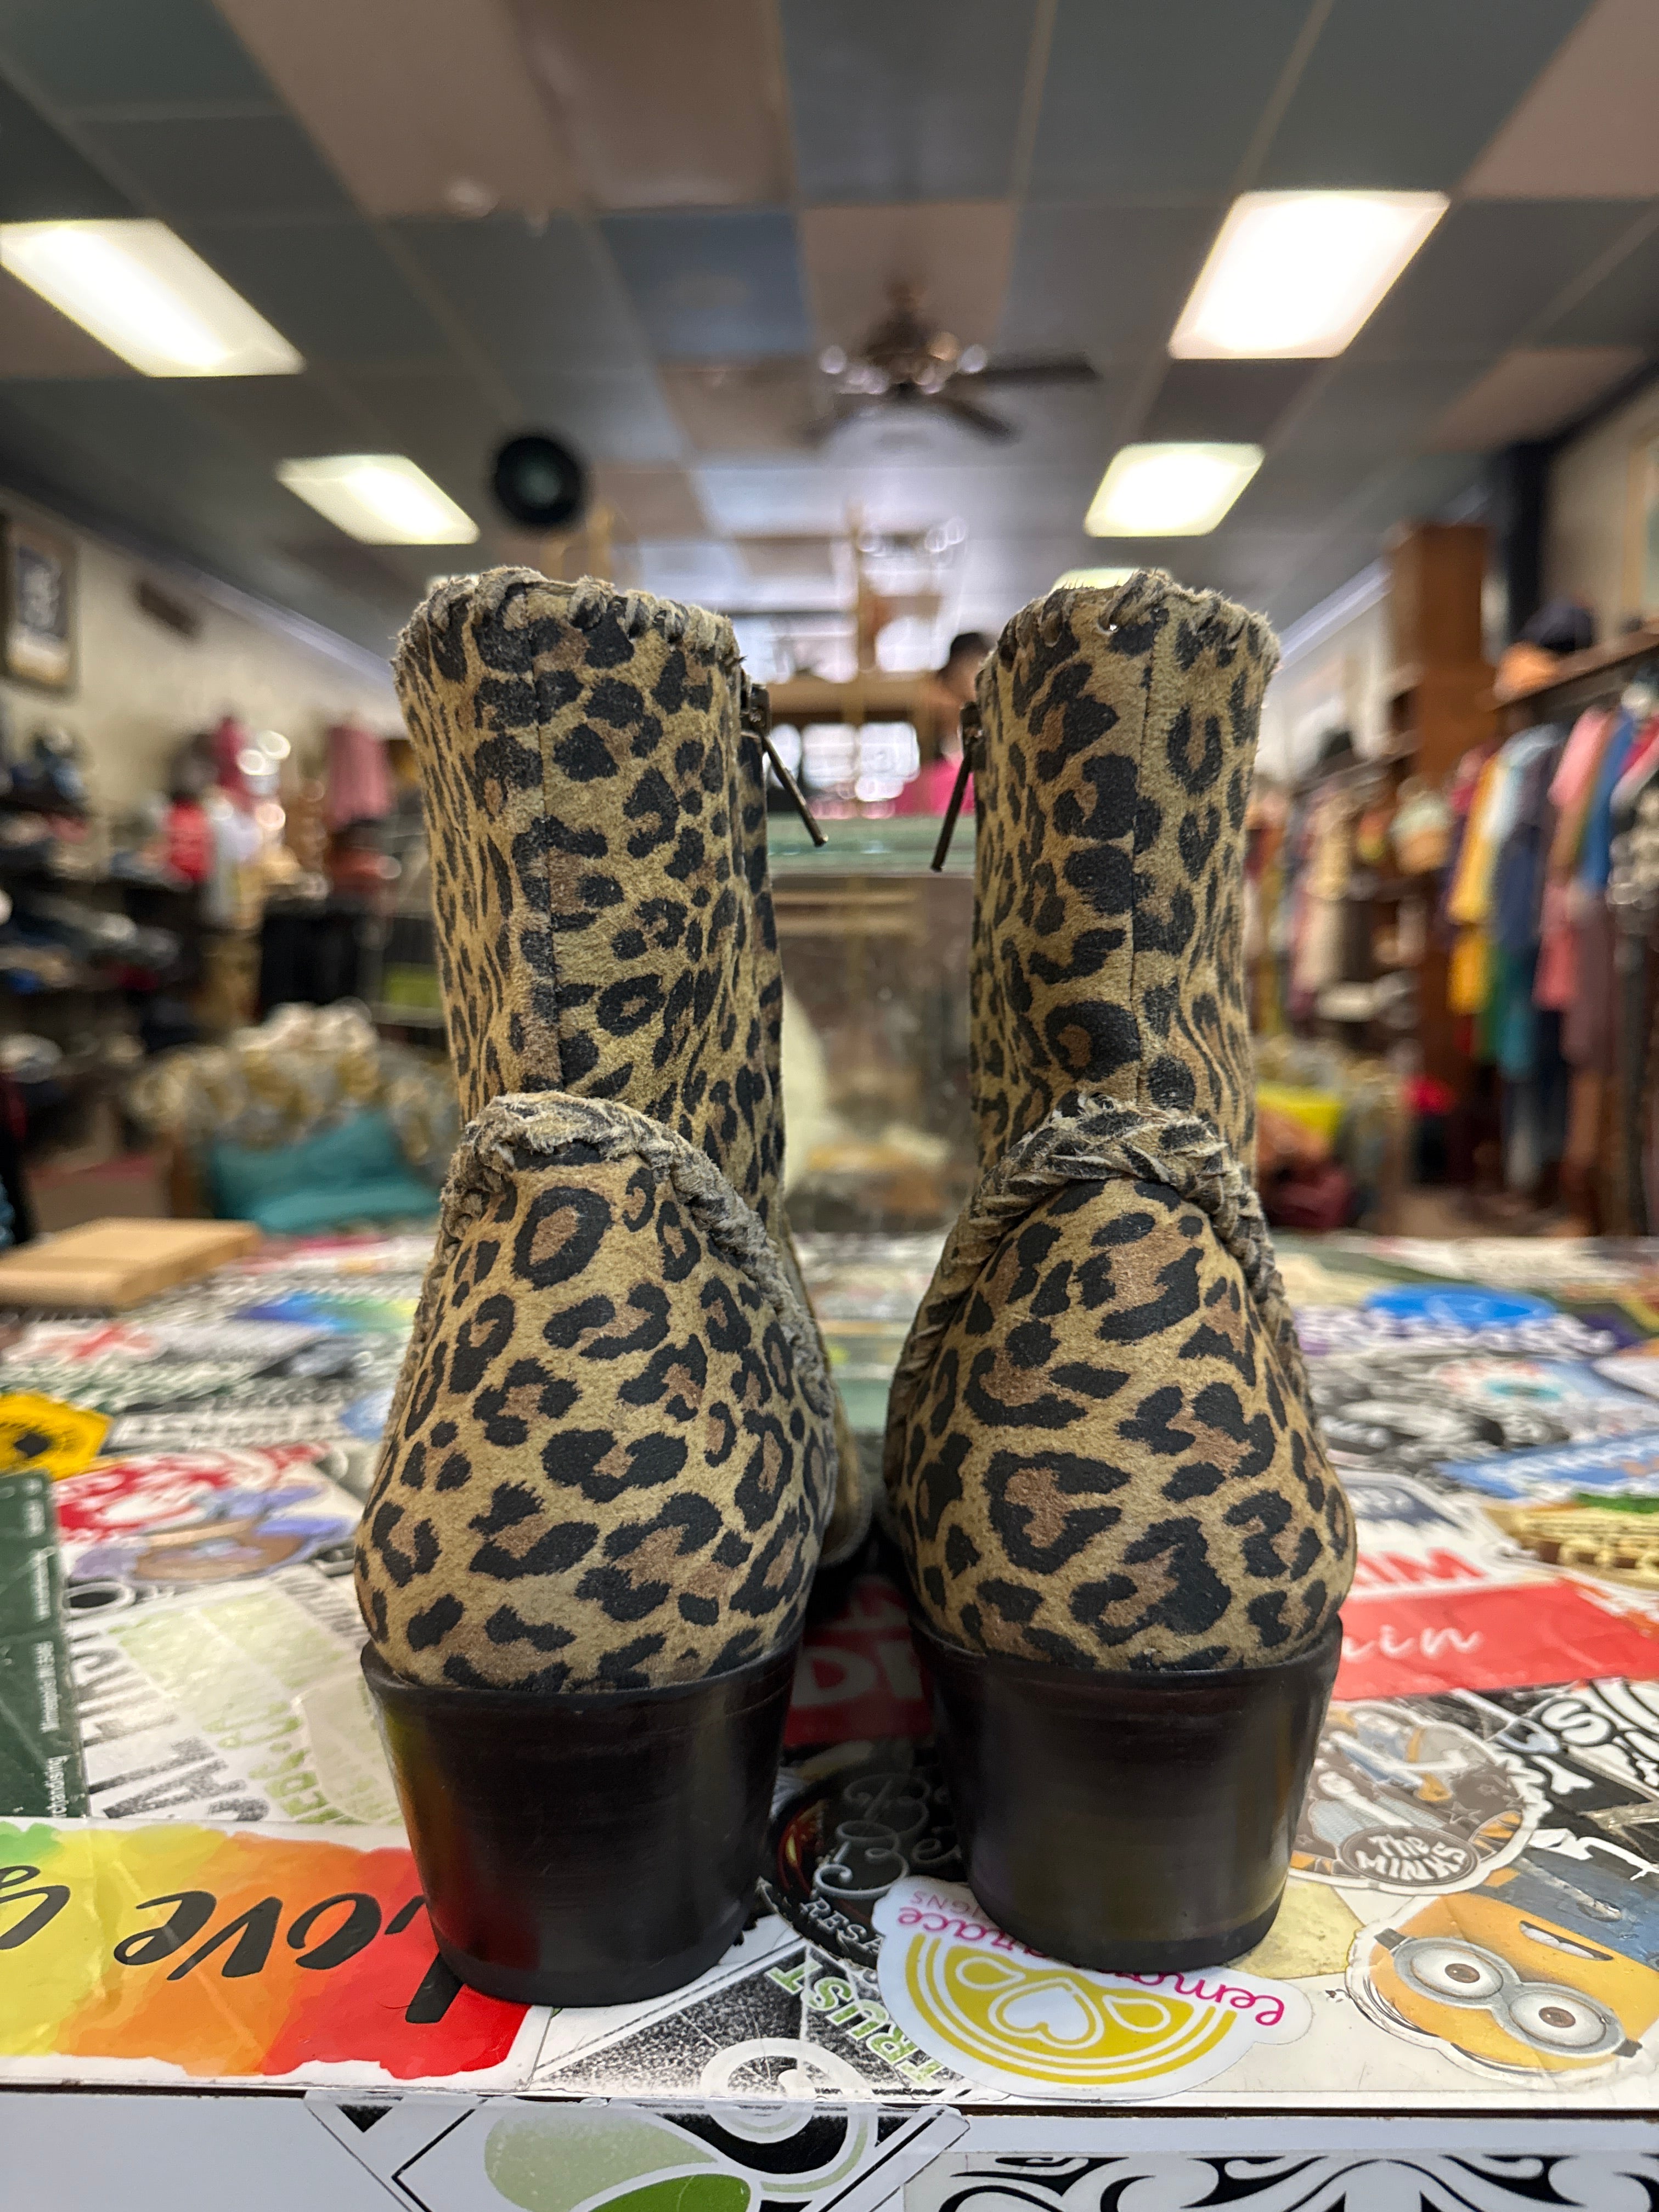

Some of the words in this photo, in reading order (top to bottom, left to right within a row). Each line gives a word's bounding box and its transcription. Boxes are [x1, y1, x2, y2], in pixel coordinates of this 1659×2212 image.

[43, 1754, 70, 1818] rchandising
[1355, 1841, 1468, 1881] MINKS
[1368, 1833, 1430, 1858] The
[799, 1897, 884, 1955] RESA
[764, 1953, 944, 2084] TRUST
